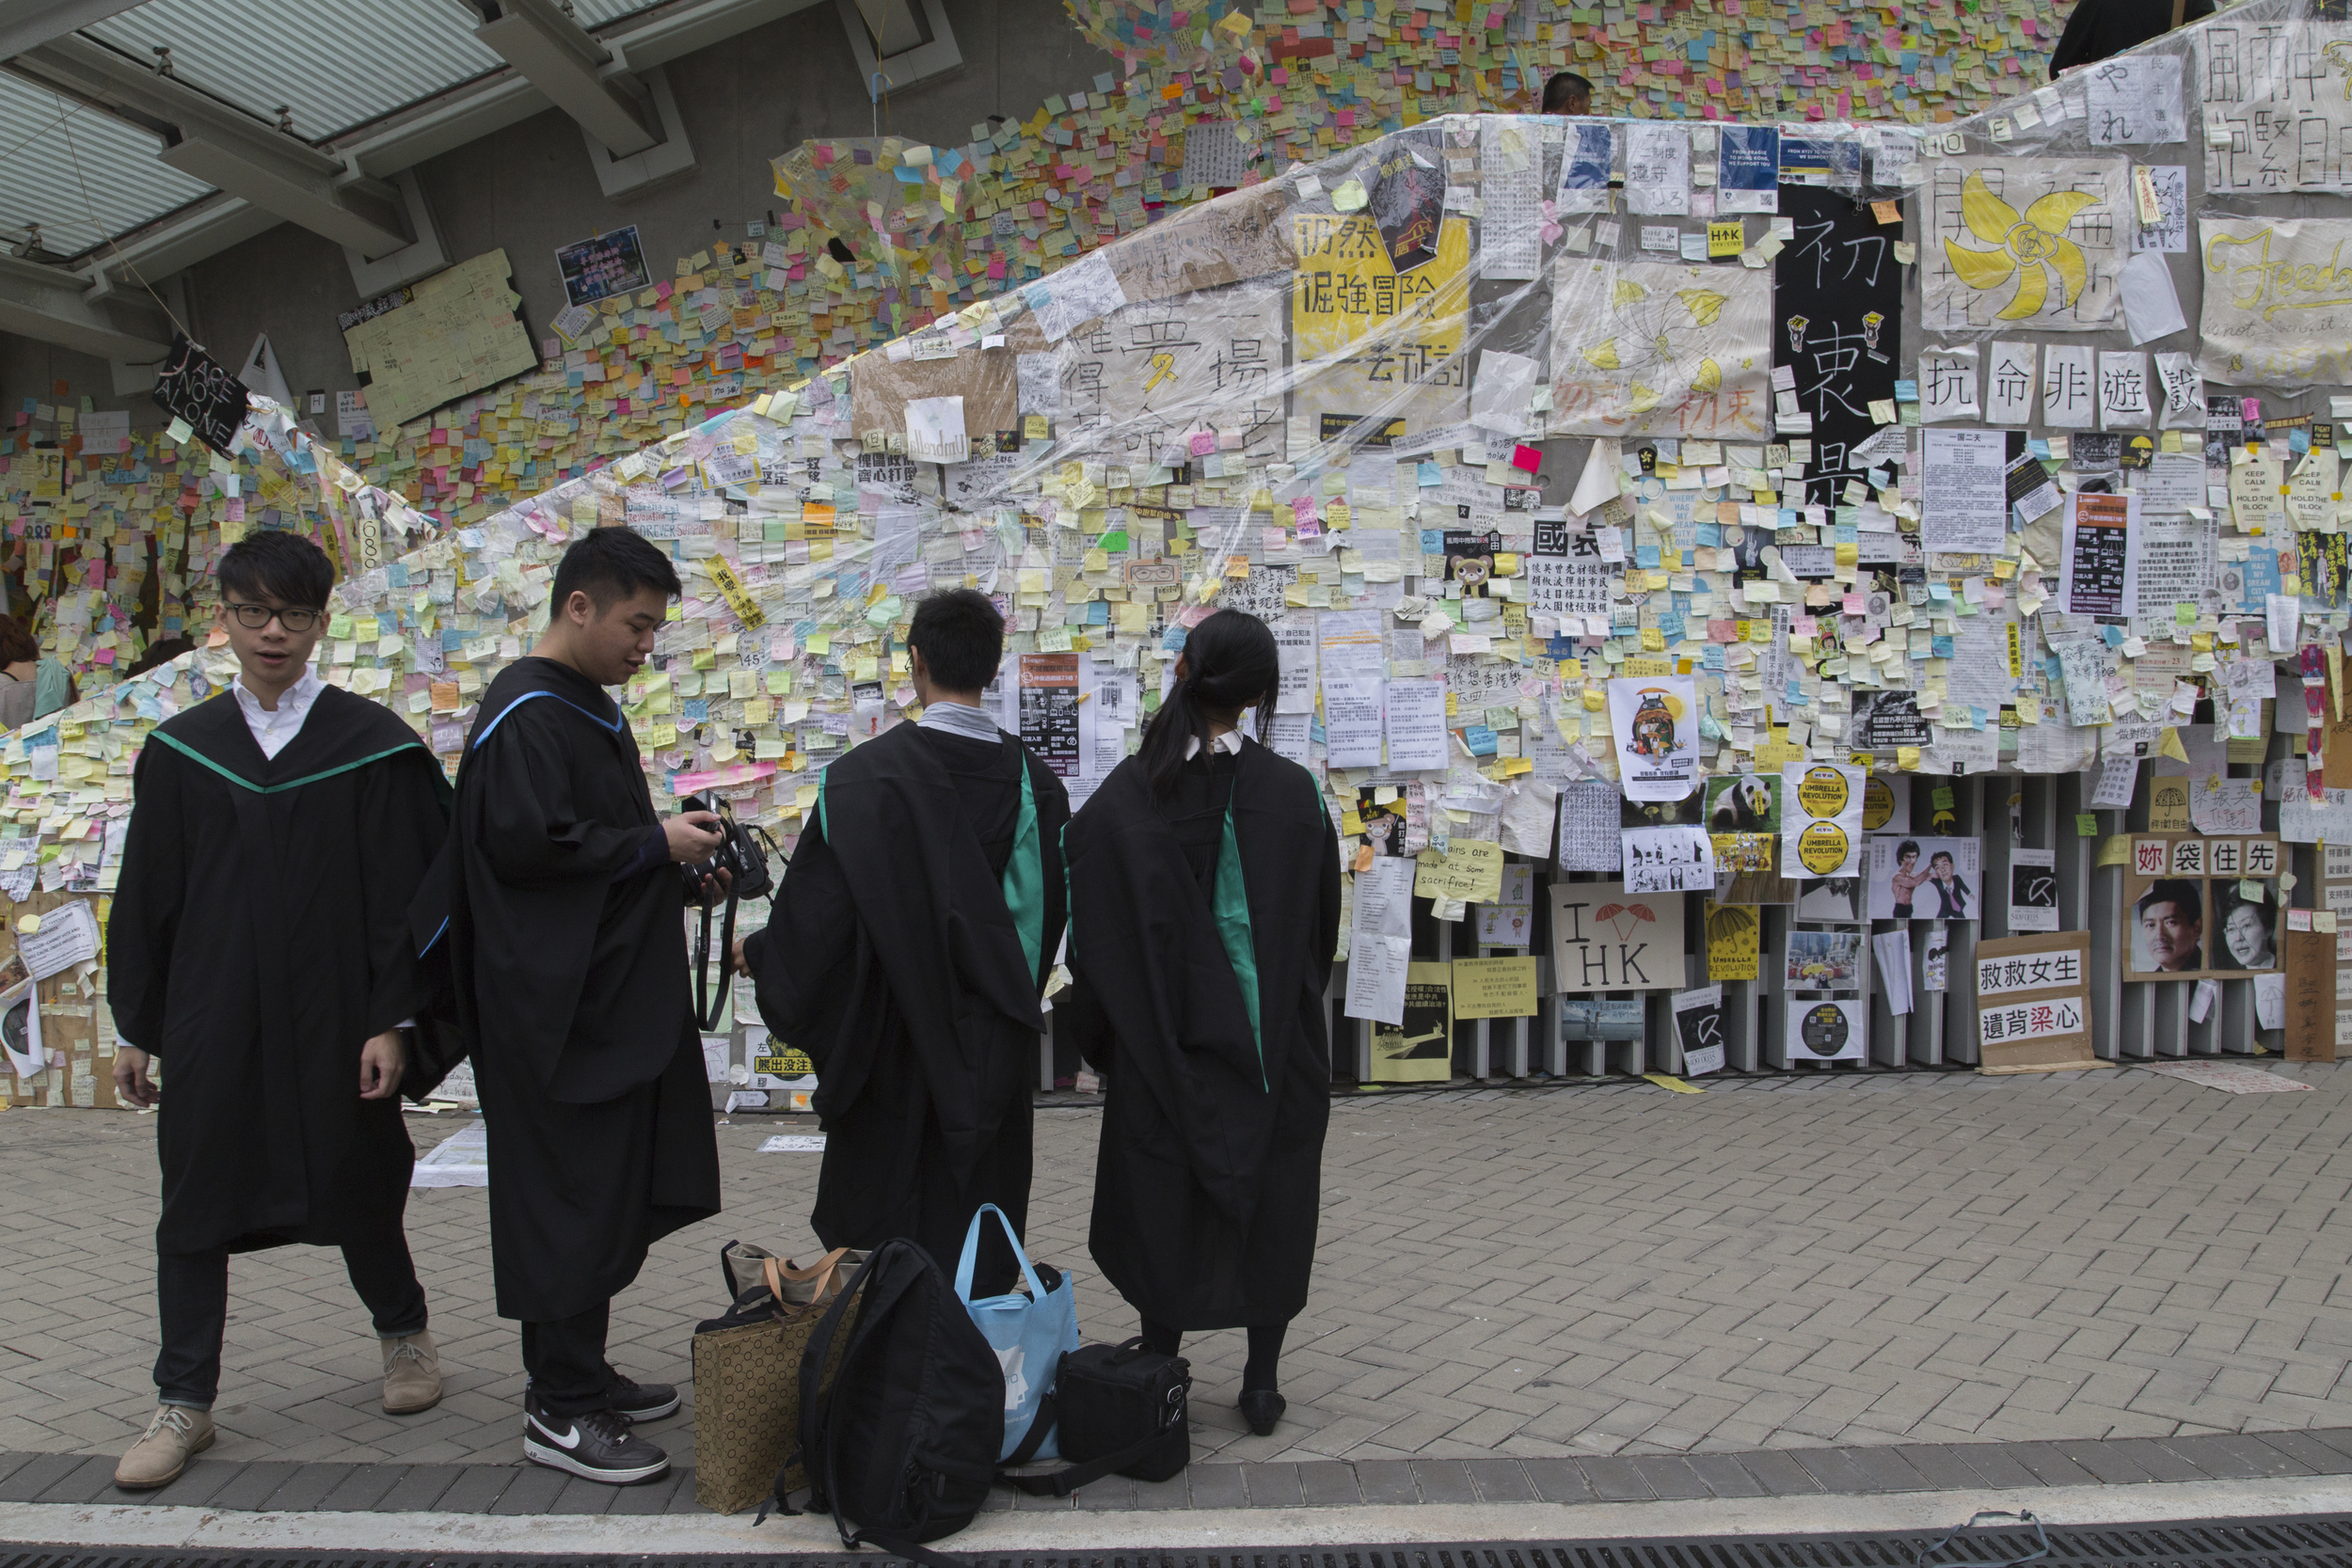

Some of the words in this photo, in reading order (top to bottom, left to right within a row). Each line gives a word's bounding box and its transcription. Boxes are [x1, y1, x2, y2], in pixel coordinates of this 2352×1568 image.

[1647, 130, 1670, 142] 一国
[1641, 147, 1676, 160] 二制度
[2207, 108, 2352, 188] 抱緊自
[1297, 218, 1379, 260] 仍然
[1298, 272, 1438, 320] 倔強冒險
[192, 360, 237, 404] ARE
[1927, 358, 2201, 415] 抗命非遊戲
[179, 371, 224, 416] NOT
[313, 397, 323, 407] H
[154, 378, 232, 448] ALONE
[2313, 424, 2331, 433] FIGHT
[864, 432, 881, 448] 但
[761, 471, 820, 486] 坚定移
[858, 468, 916, 483] 齊心打倒
[1452, 469, 1485, 483] 對不起!
[1669, 494, 1695, 502] WHERE
[675, 523, 711, 536] SUPPOR
[1490, 532, 1500, 551] 自由
[2199, 520, 2209, 588] 振英下台治標不治本
[2251, 562, 2266, 570] HAS
[2248, 578, 2271, 587] DREAM
[2007, 623, 2022, 666] 我要真普選
[2119, 726, 2161, 740] 做對的事
[1802, 792, 1843, 800] REVOLUTION
[1805, 784, 1841, 793] UMBRELLA
[1806, 839, 1841, 847] UMBRELLA
[1471, 848, 1489, 858] are
[2137, 843, 2274, 872] 妳袋住先
[1417, 860, 1438, 869] made
[1448, 862, 1460, 871] at
[1421, 876, 1475, 891] sacrifice!
[1563, 902, 1591, 943] I
[1579, 942, 1651, 987] HK
[1708, 963, 1756, 973] REVOLUTION
[1980, 955, 2078, 990] 救救女生
[1982, 1003, 2080, 1040] 遺背梁心
[757, 1042, 768, 1053] 左
